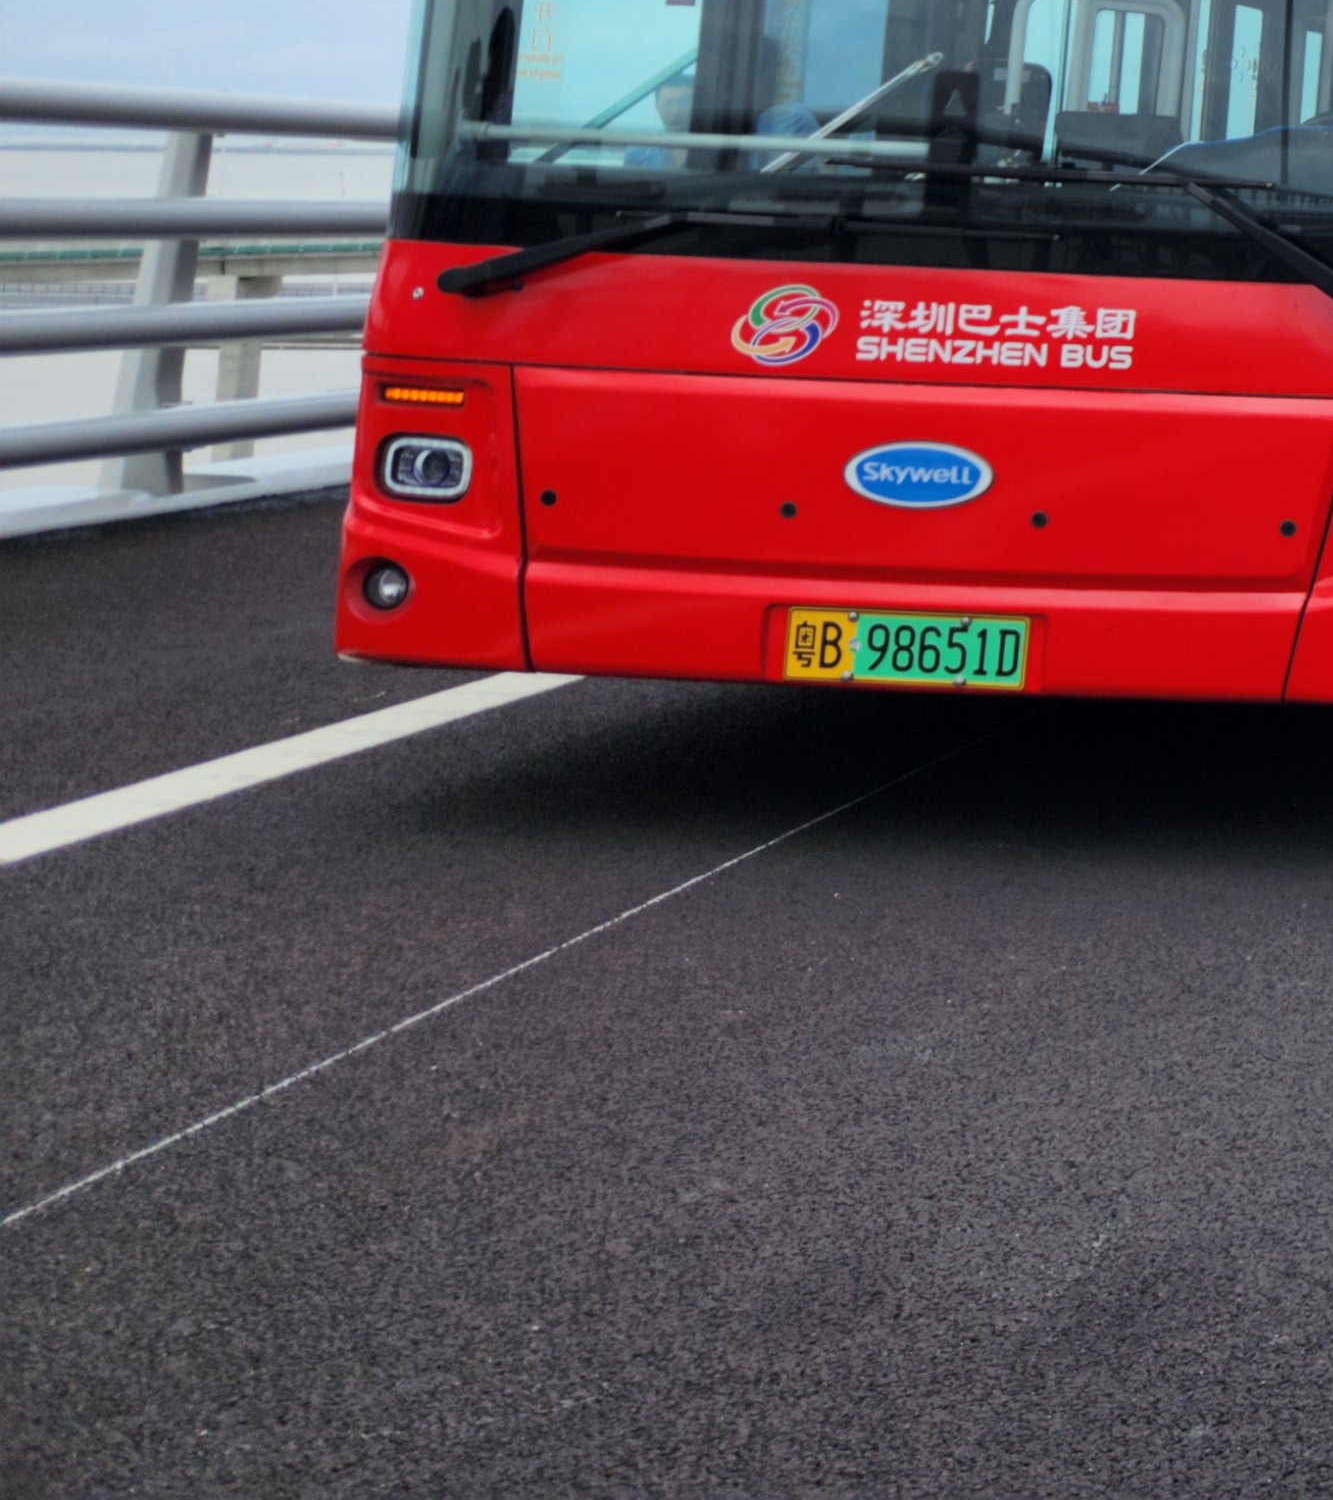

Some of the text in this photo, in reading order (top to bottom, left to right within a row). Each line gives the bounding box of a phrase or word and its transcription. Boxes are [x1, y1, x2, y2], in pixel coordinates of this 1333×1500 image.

[859, 299, 1136, 340] 深圳巴士集团
[855, 336, 1133, 370] SHENZHEN BUS
